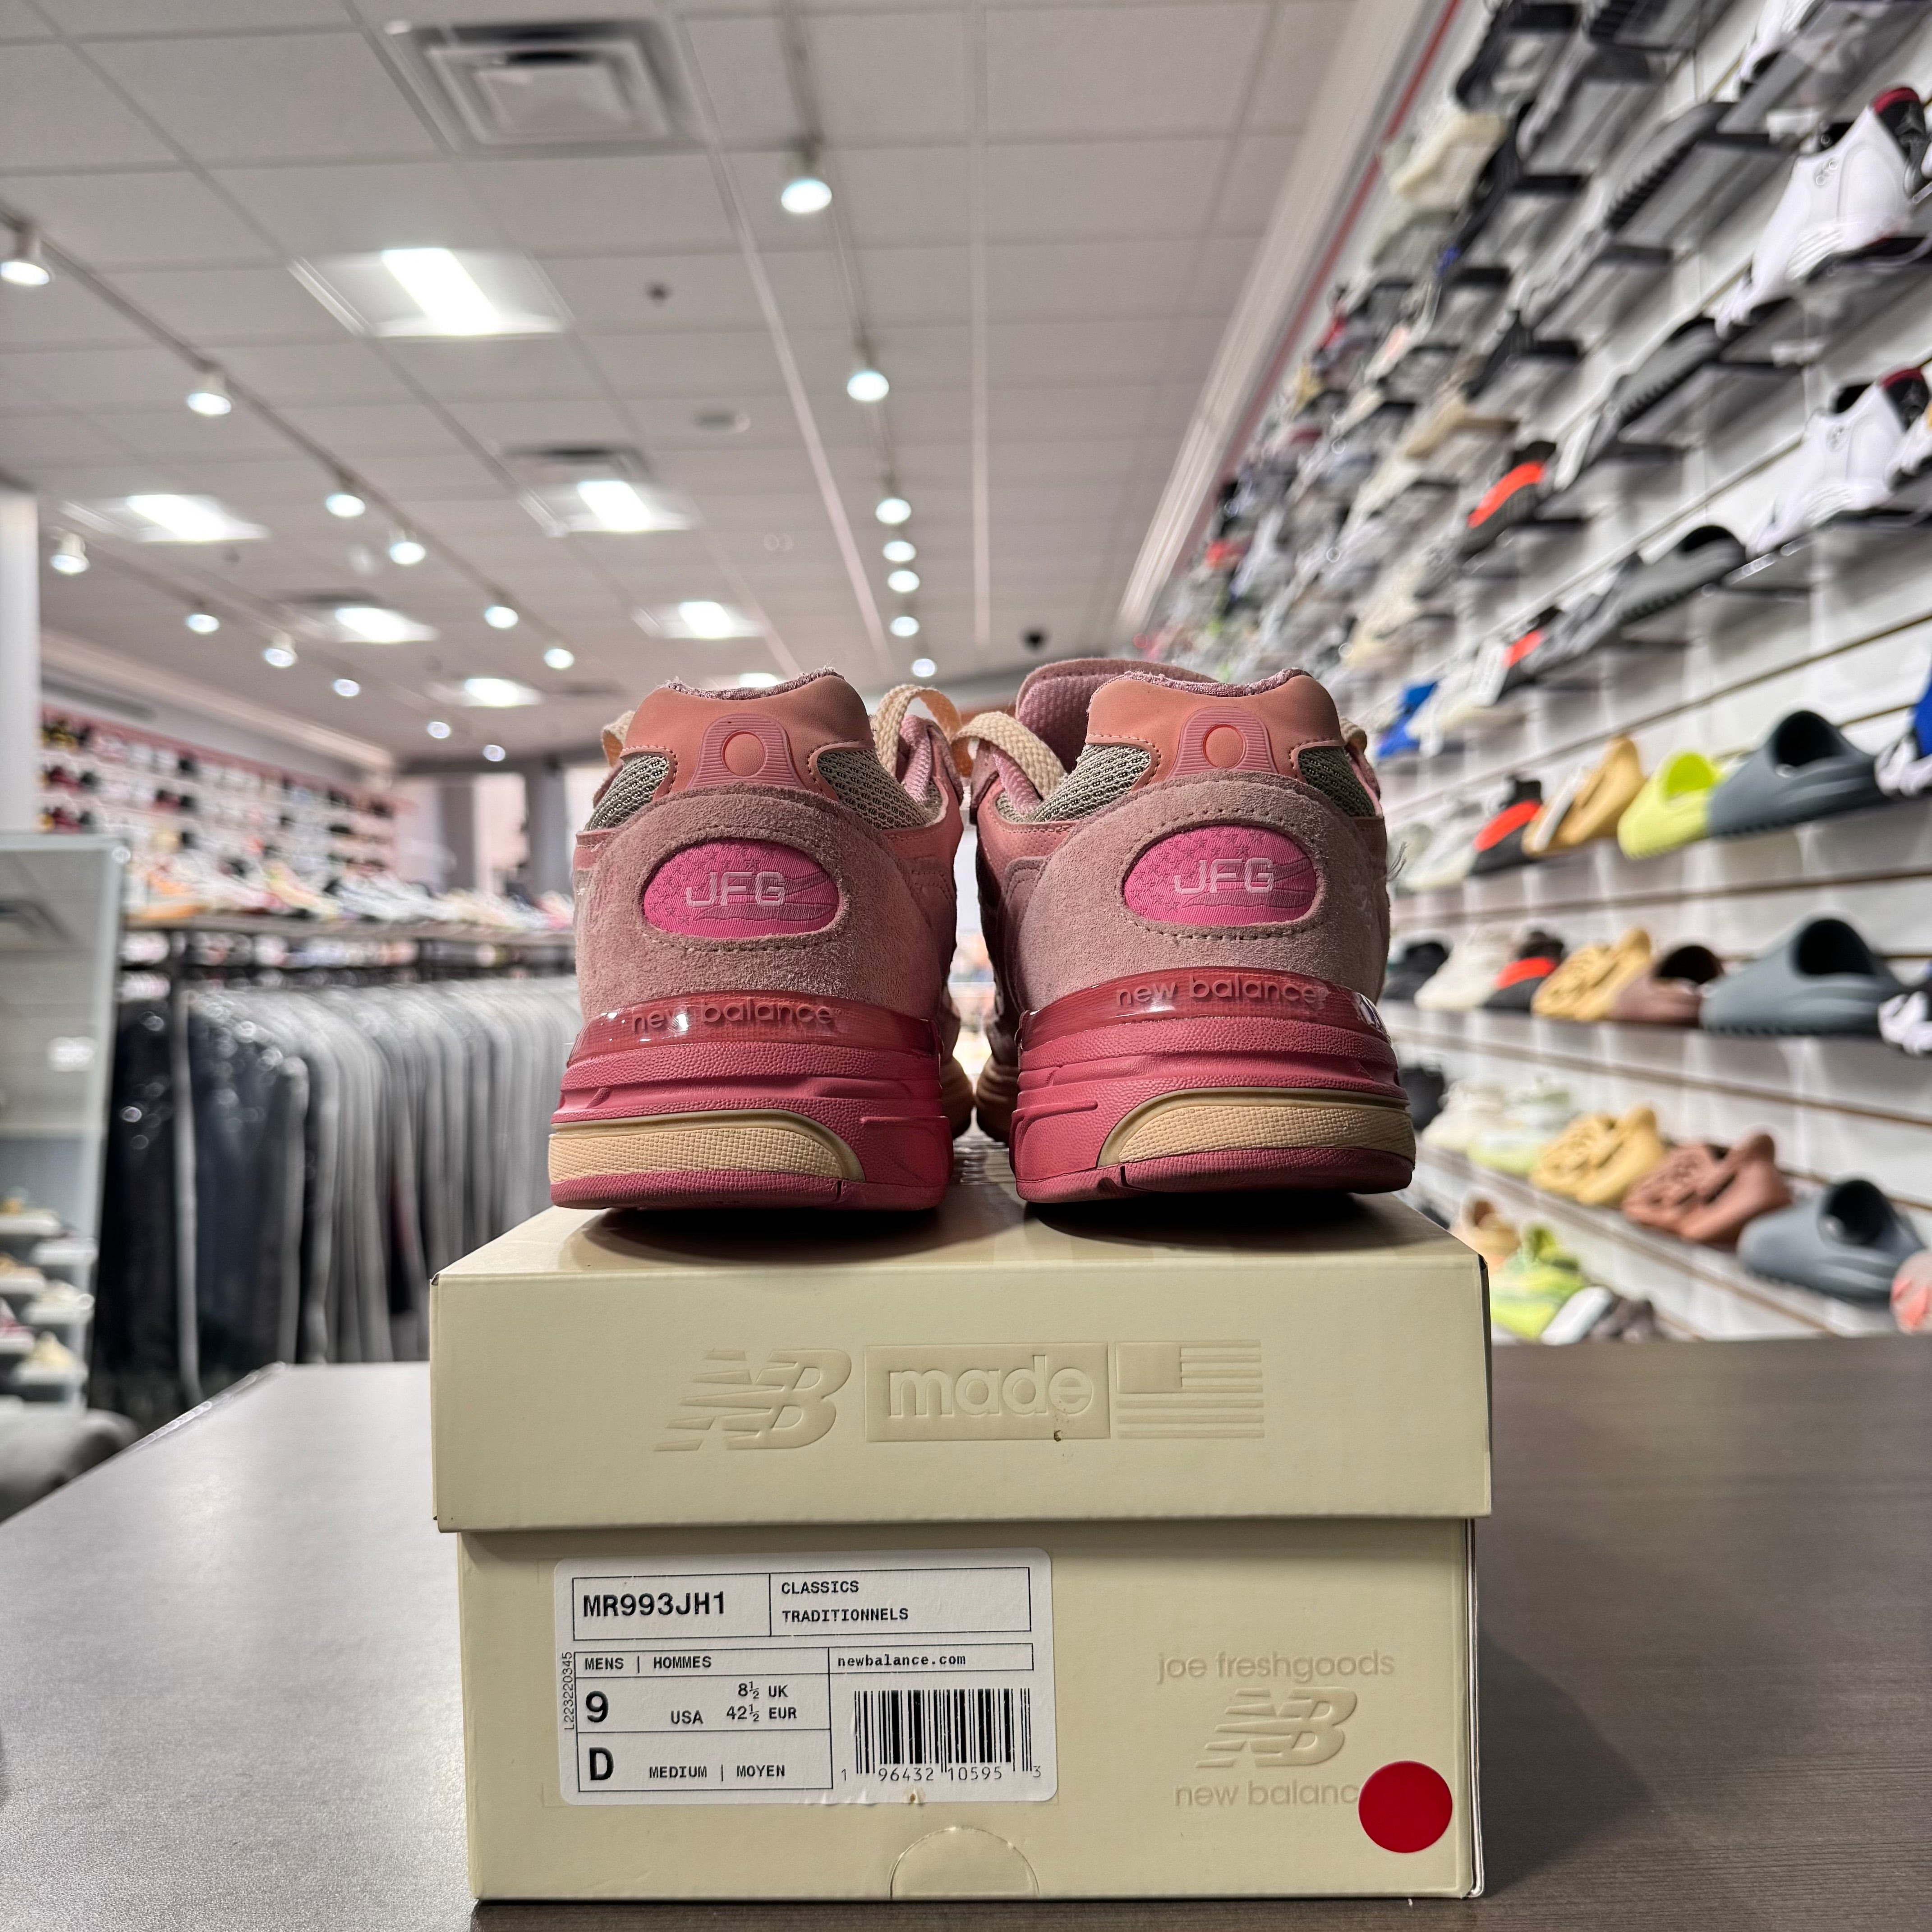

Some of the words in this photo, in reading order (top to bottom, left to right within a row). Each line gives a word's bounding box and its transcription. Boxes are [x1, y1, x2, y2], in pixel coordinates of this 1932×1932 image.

[1173, 856, 1277, 895] JFG
[686, 871, 787, 908] JFG
[1116, 981, 1177, 1006] new
[701, 997, 834, 1025] balance
[888, 1354, 1093, 1417] made
[781, 1580, 859, 1595] CLASSICS
[583, 1591, 724, 1617] MR993JH1
[782, 1607, 909, 1623] TRADITIONNELS
[585, 1657, 624, 1670] MENS
[653, 1656, 712, 1669] HOMMES
[838, 1653, 966, 1667] newbalance.com
[1157, 1652, 1207, 1685] joe
[1215, 1649, 1395, 1684] freshgoods
[561, 1651, 574, 1730] L223220345
[768, 1684, 788, 1697] UK
[585, 1690, 609, 1723] 9
[671, 1710, 704, 1725] USA
[768, 1707, 797, 1720] EUR
[589, 1747, 614, 1781] D
[649, 1766, 707, 1779] MEDIUM
[736, 1764, 785, 1777] MOYEN
[841, 1768, 846, 1781] 1
[878, 1767, 934, 1782] 96432
[948, 1766, 1002, 1781] 10595
[1033, 1765, 1041, 1778] 3
[1175, 1781, 1238, 1806] new
[1247, 1779, 1359, 1806] balanc
